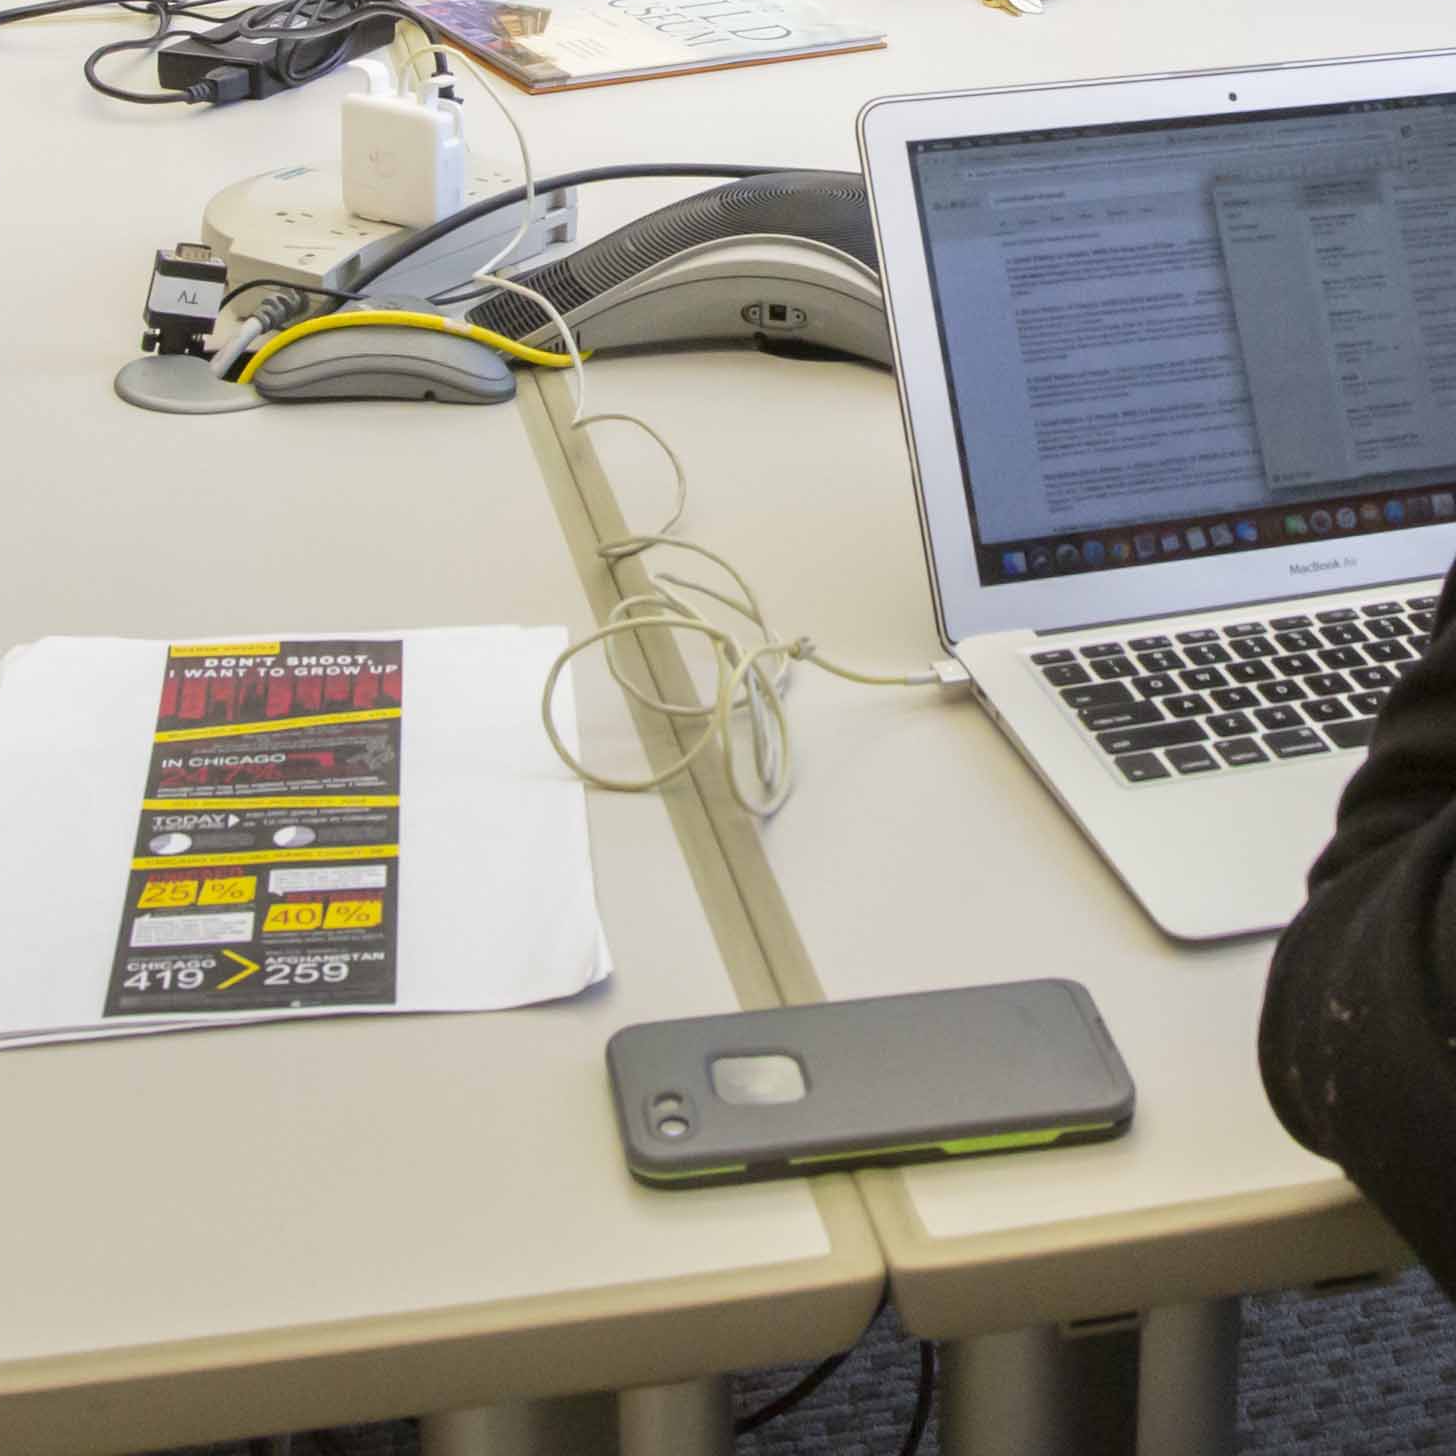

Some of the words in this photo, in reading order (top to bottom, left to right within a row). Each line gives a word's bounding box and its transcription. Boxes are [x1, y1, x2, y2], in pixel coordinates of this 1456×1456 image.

[176, 290, 198, 305] TV
[1288, 559, 1340, 575] MacBook
[204, 656, 277, 667] DON'T
[168, 669, 175, 679] I
[184, 668, 247, 678] WANT
[256, 666, 286, 678] TO
[294, 665, 360, 676] GROW
[369, 664, 399, 674] UP
[161, 758, 183, 769] IN
[187, 753, 287, 768] CHICAGO
[152, 813, 226, 826] TODAY
[146, 884, 191, 902] 25
[270, 908, 317, 926] 40
[335, 903, 370, 922] %
[127, 958, 217, 972] CHICAGO
[264, 951, 385, 966] AFGHANISTAN
[123, 969, 205, 992] 419
[263, 962, 349, 986] 259
